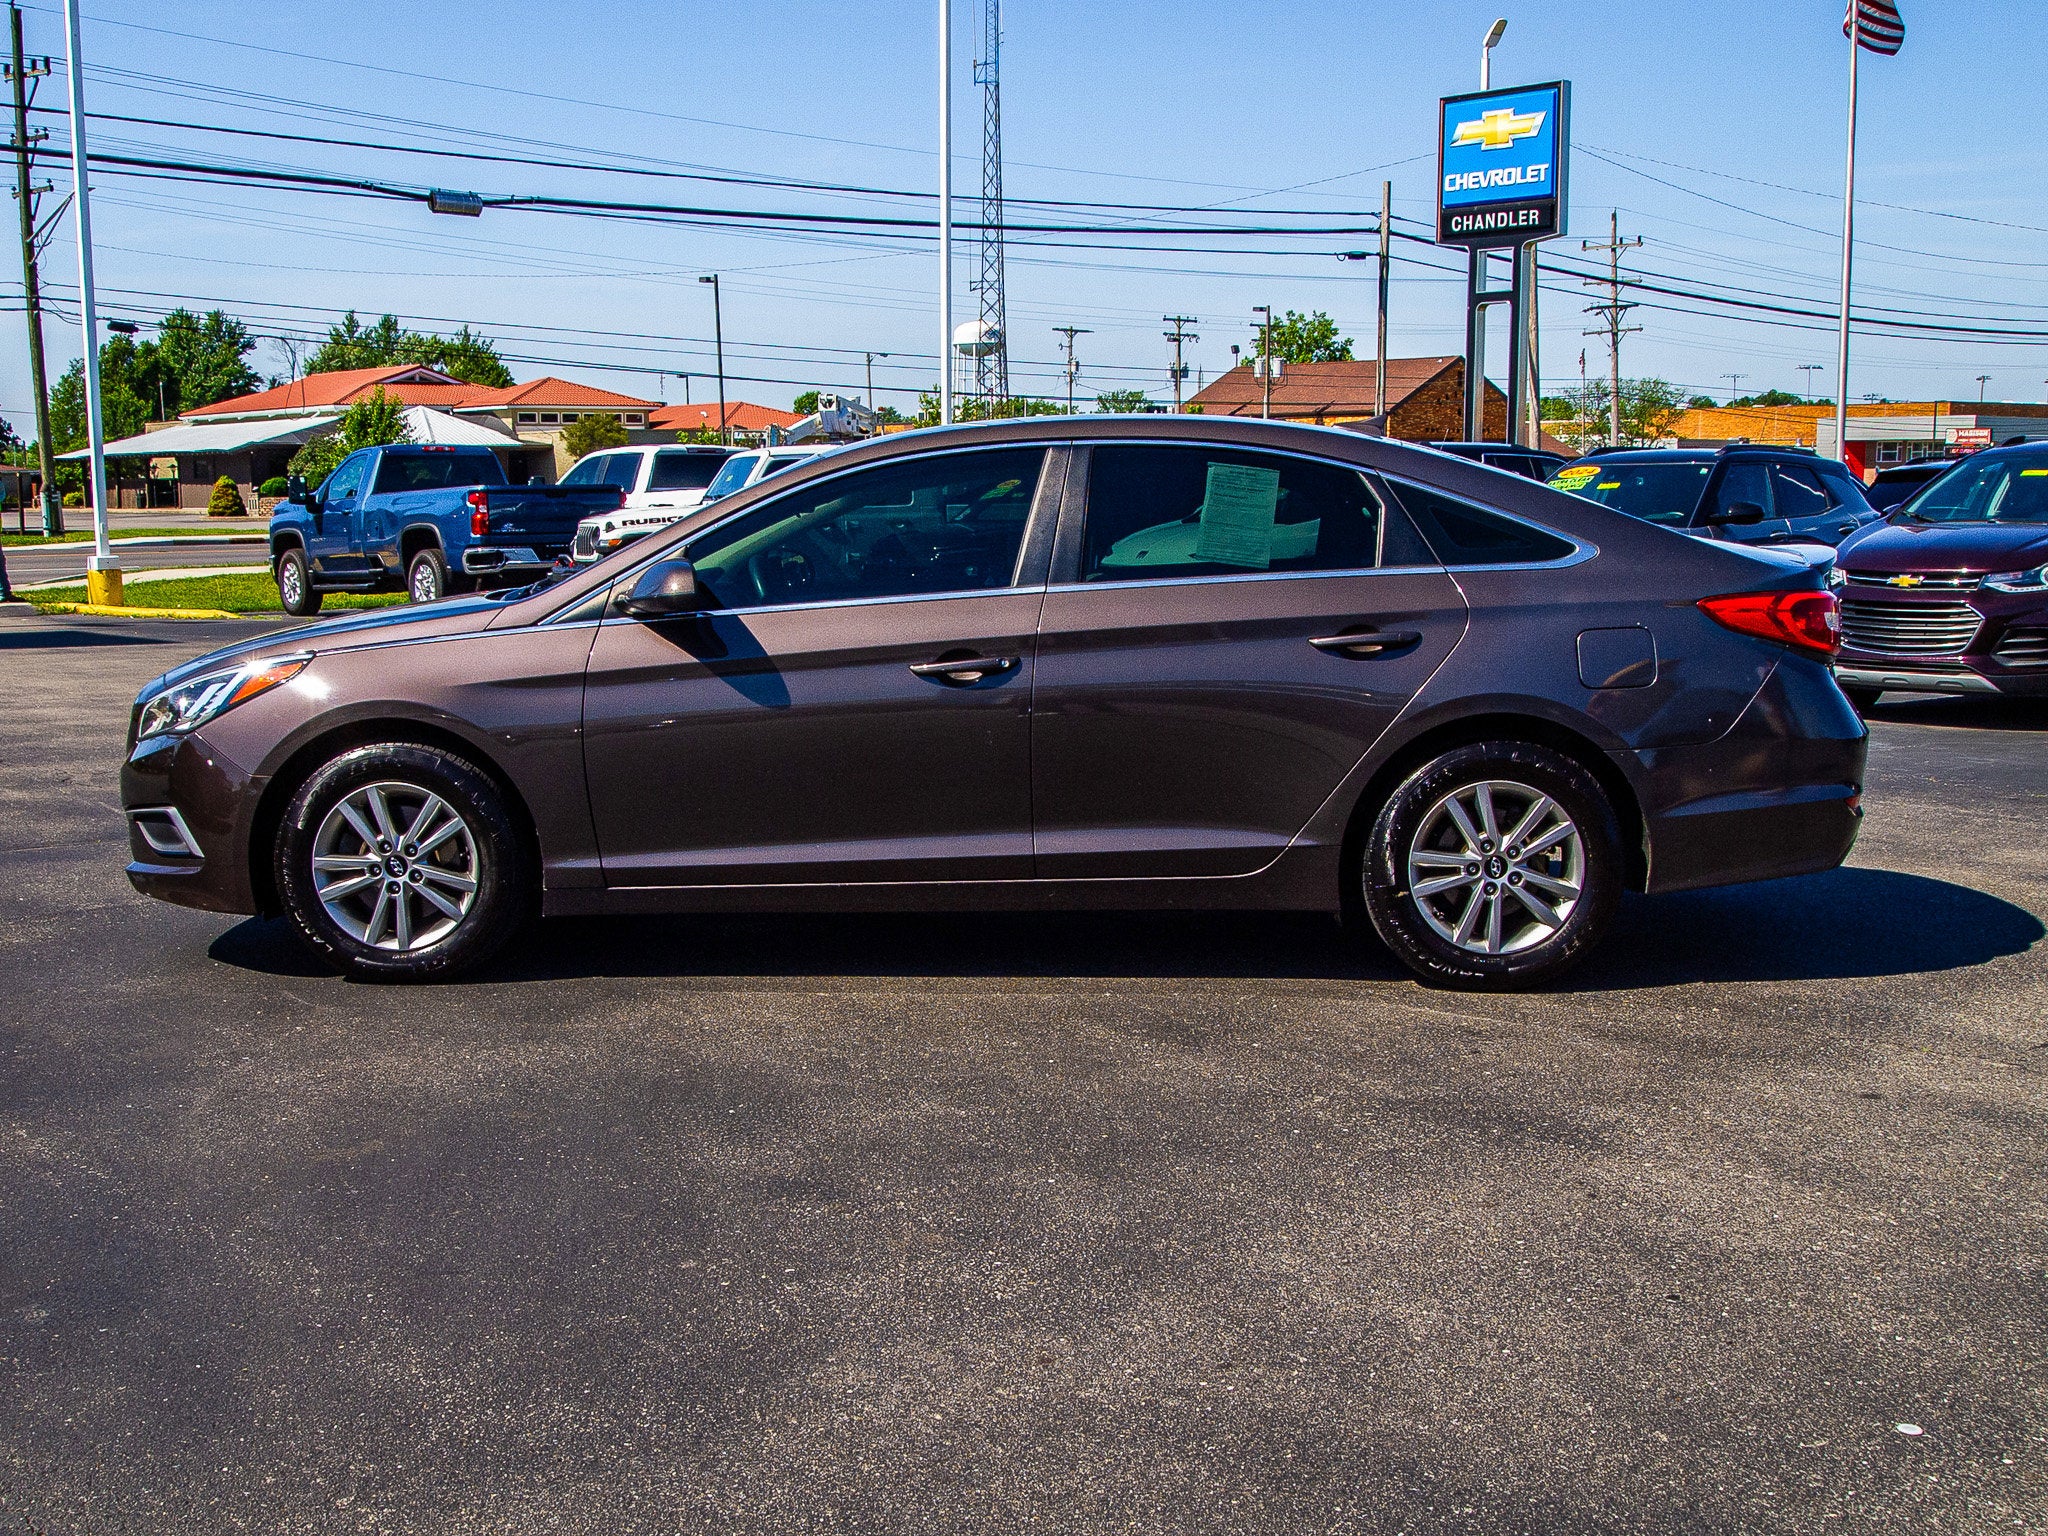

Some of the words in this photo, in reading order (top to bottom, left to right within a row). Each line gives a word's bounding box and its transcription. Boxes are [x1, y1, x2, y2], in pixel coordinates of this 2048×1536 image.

[1444, 163, 1550, 192] CHEVROLET
[1451, 209, 1540, 232] CHANDLER
[621, 515, 683, 526] RUBIC
